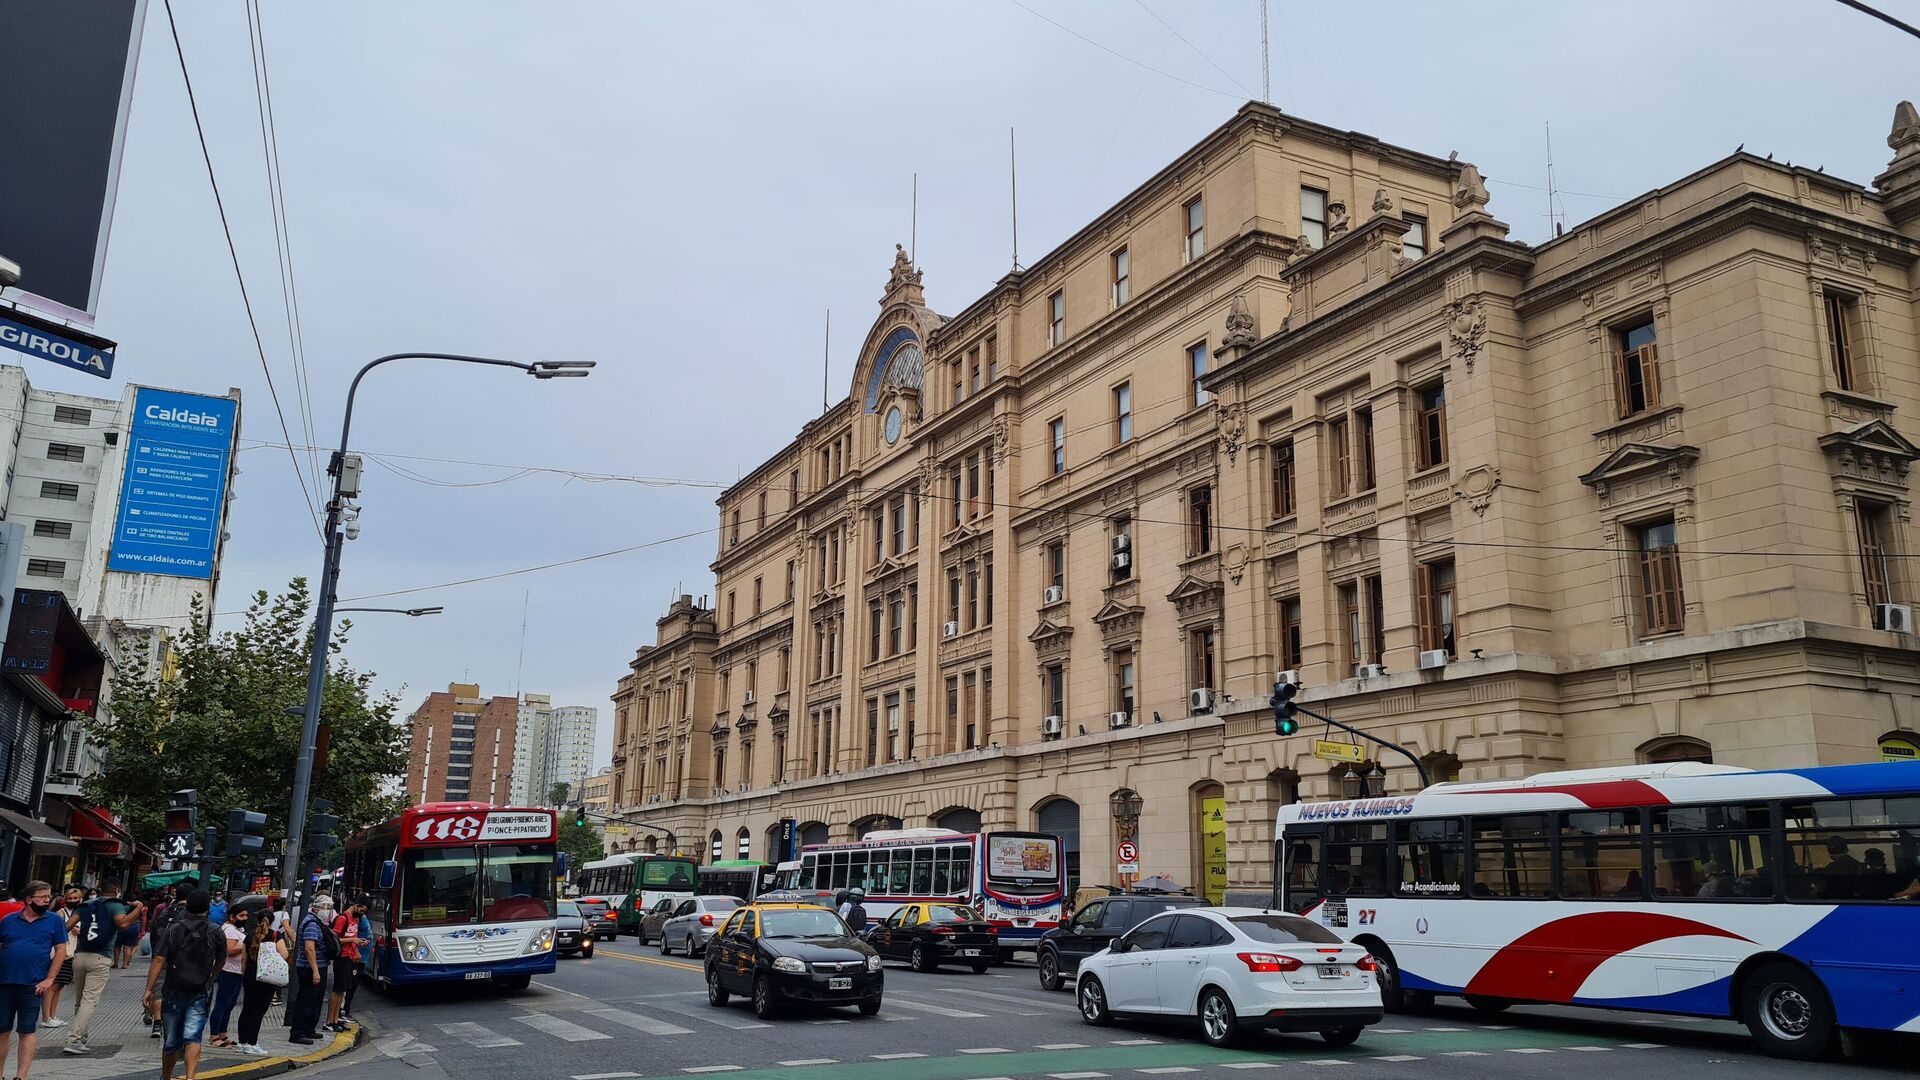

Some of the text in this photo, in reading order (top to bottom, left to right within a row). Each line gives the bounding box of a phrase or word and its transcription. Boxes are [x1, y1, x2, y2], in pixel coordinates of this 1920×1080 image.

[0, 325, 106, 371] GIROLA
[145, 404, 218, 427] Caldaia
[117, 552, 207, 568] www.caldaia.com.ar
[1298, 798, 1415, 820] NUEVOS RUMBOS
[414, 815, 480, 841] 118
[1211, 866, 1226, 875] FILA
[1400, 881, 1461, 892] Aire Acondicionado
[1337, 914, 1348, 923] 132
[1358, 908, 1377, 925] 27
